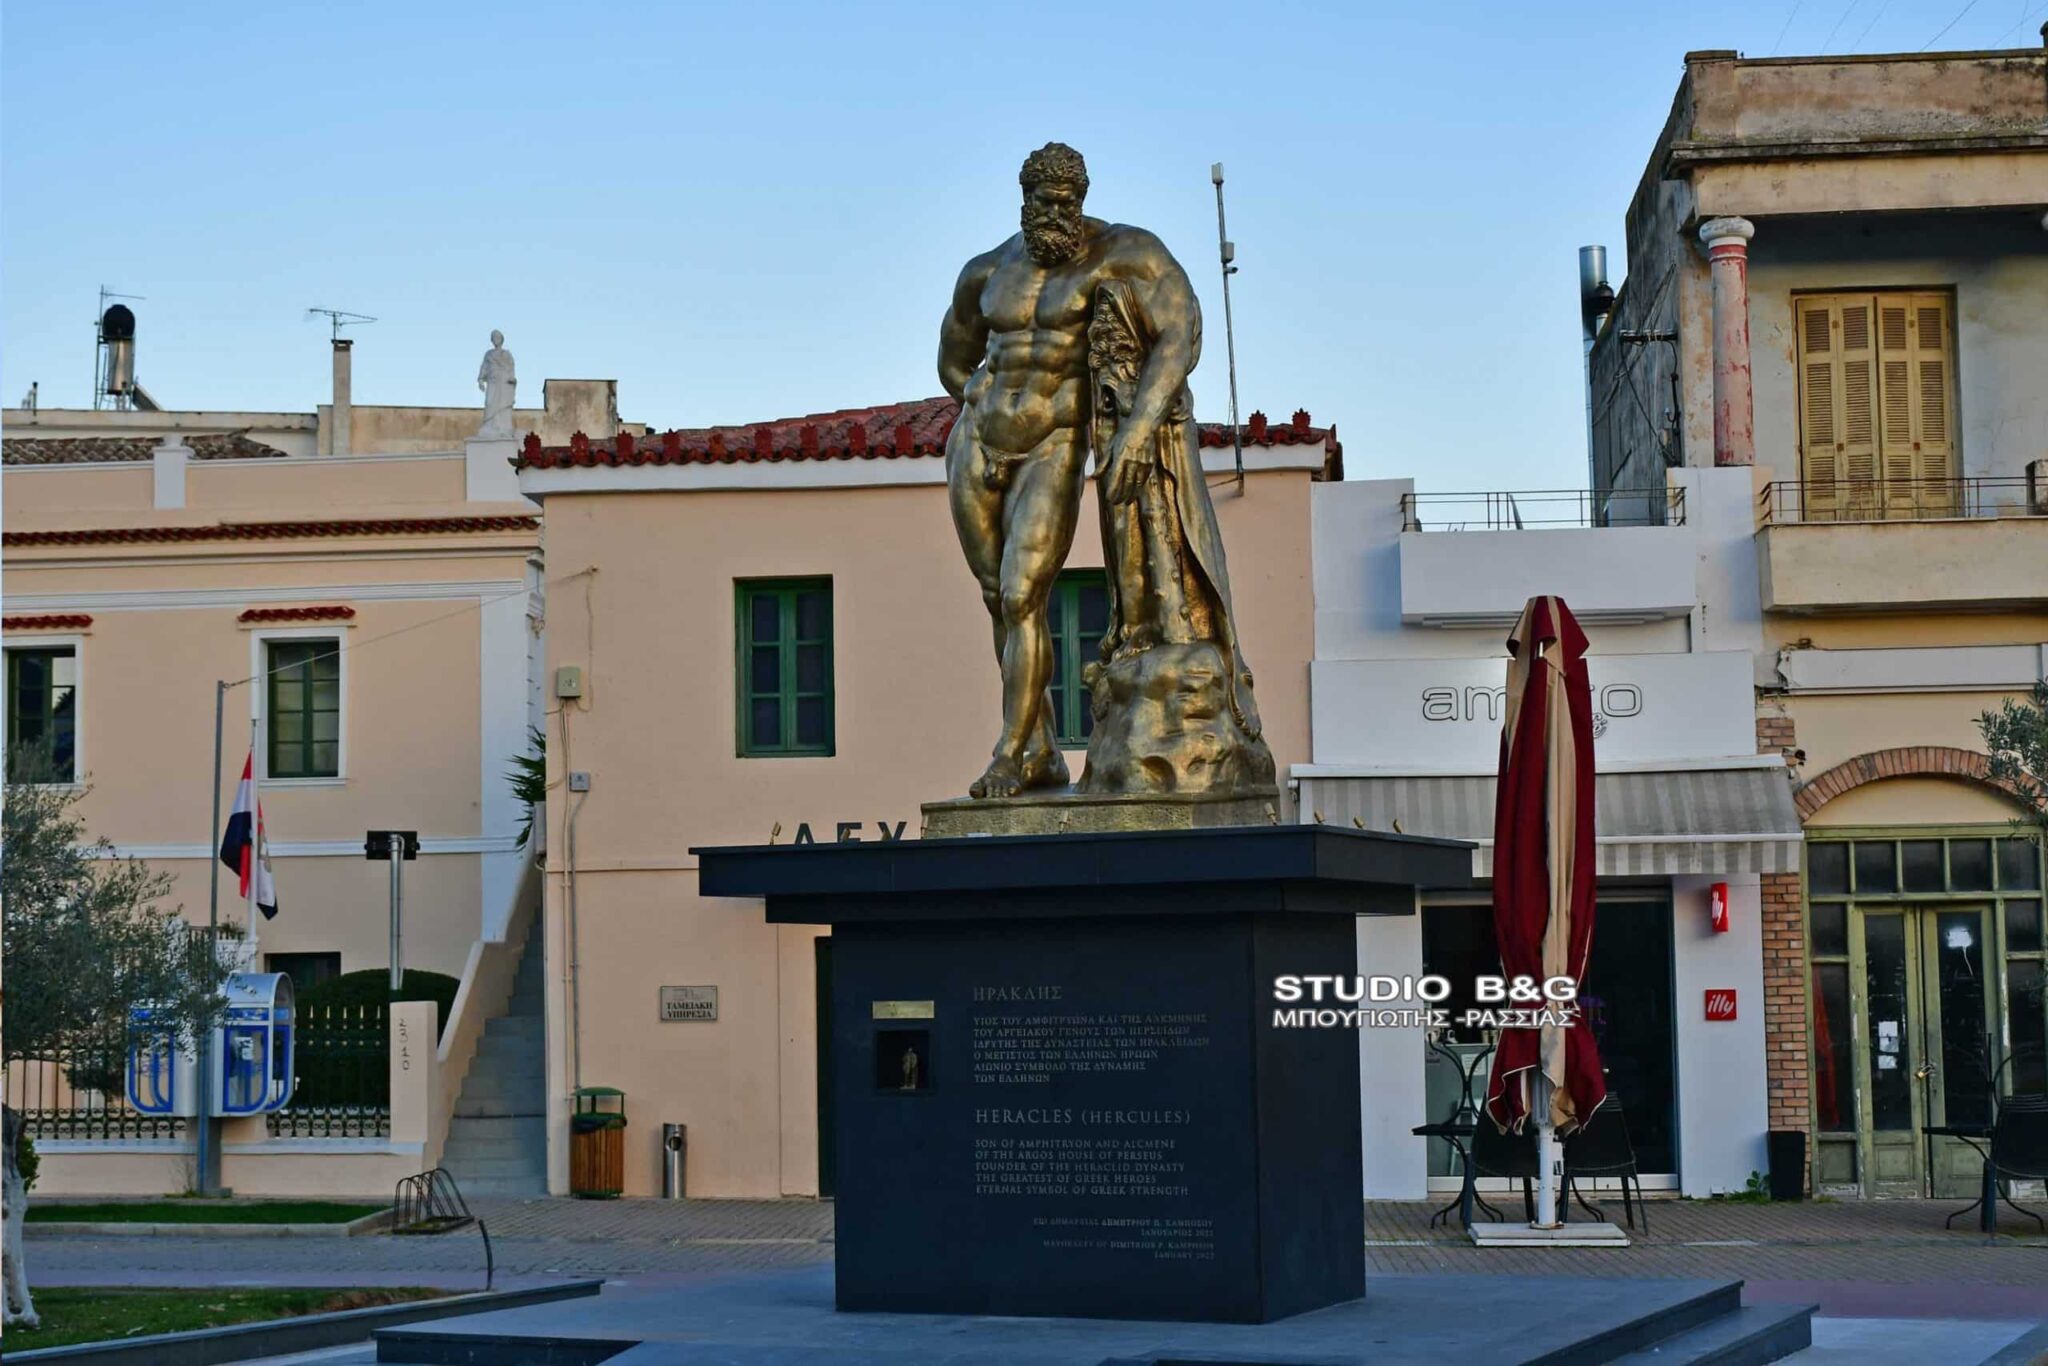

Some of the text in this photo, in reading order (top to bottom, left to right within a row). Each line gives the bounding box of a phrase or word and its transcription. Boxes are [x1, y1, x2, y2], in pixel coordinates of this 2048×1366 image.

[1423, 684, 1642, 721] amo
[973, 986, 1062, 1001] ΗΡΑΚΛΗΣ
[1707, 994, 1735, 1017] illy
[973, 1016, 999, 1026] ΥΙΟΣ
[1001, 1016, 1022, 1026] ΤΟΥ
[1098, 1014, 1118, 1025] ΚΑΙ
[1120, 1014, 1142, 1024] ΤΗΣ
[973, 1028, 994, 1038] ΤΟΥ
[996, 1028, 1056, 1038] ΑΡΓΕΙΑΚΟΥ
[1058, 1027, 1101, 1037] ΓΕΝΟΥΣ
[1104, 1027, 1126, 1036] ΤΩΝ
[973, 1039, 1018, 1049] ΙΔΡΥΤΗΣ
[1020, 1039, 1042, 1048] ΤΗΣ
[1044, 1038, 1111, 1048] ΔΥΝΑΣΤΕΙΑΣ
[1114, 1038, 1136, 1048] ΤΩΝ
[973, 1051, 981, 1060] Ο
[984, 1051, 1036, 1060] ΜΕΓΙΣΤΟΣ
[1040, 1051, 1061, 1060] ΤΩΝ
[1064, 1050, 1117, 1060] ΕΛΛΗΝΩΝ
[973, 1061, 1147, 1071] ΑΙΩΝΙΟ ΣΥΜΒΟΛΟ ΤΗΣ ΔΥΝΑΜΗΣ
[973, 1074, 1050, 1083] ΤΩΝ ΕΛΛΗΝΩΝ
[975, 1108, 1191, 1125] HERACLES (HERCULES)
[975, 1139, 1176, 1149] SON OF AMPHITRYON AND ALCMENE
[975, 1150, 1163, 1160] OF THE ARGOS HOUSE OF PERSEUS
[975, 1162, 1185, 1173] FOUNDER OF THE HERACLID DYNASTY
[975, 1173, 1157, 1184] THE GREATEST OF GREEK HEROES
[975, 1185, 1189, 1196] ETERNAL SYMBOL OF GREEK STRENGTH
